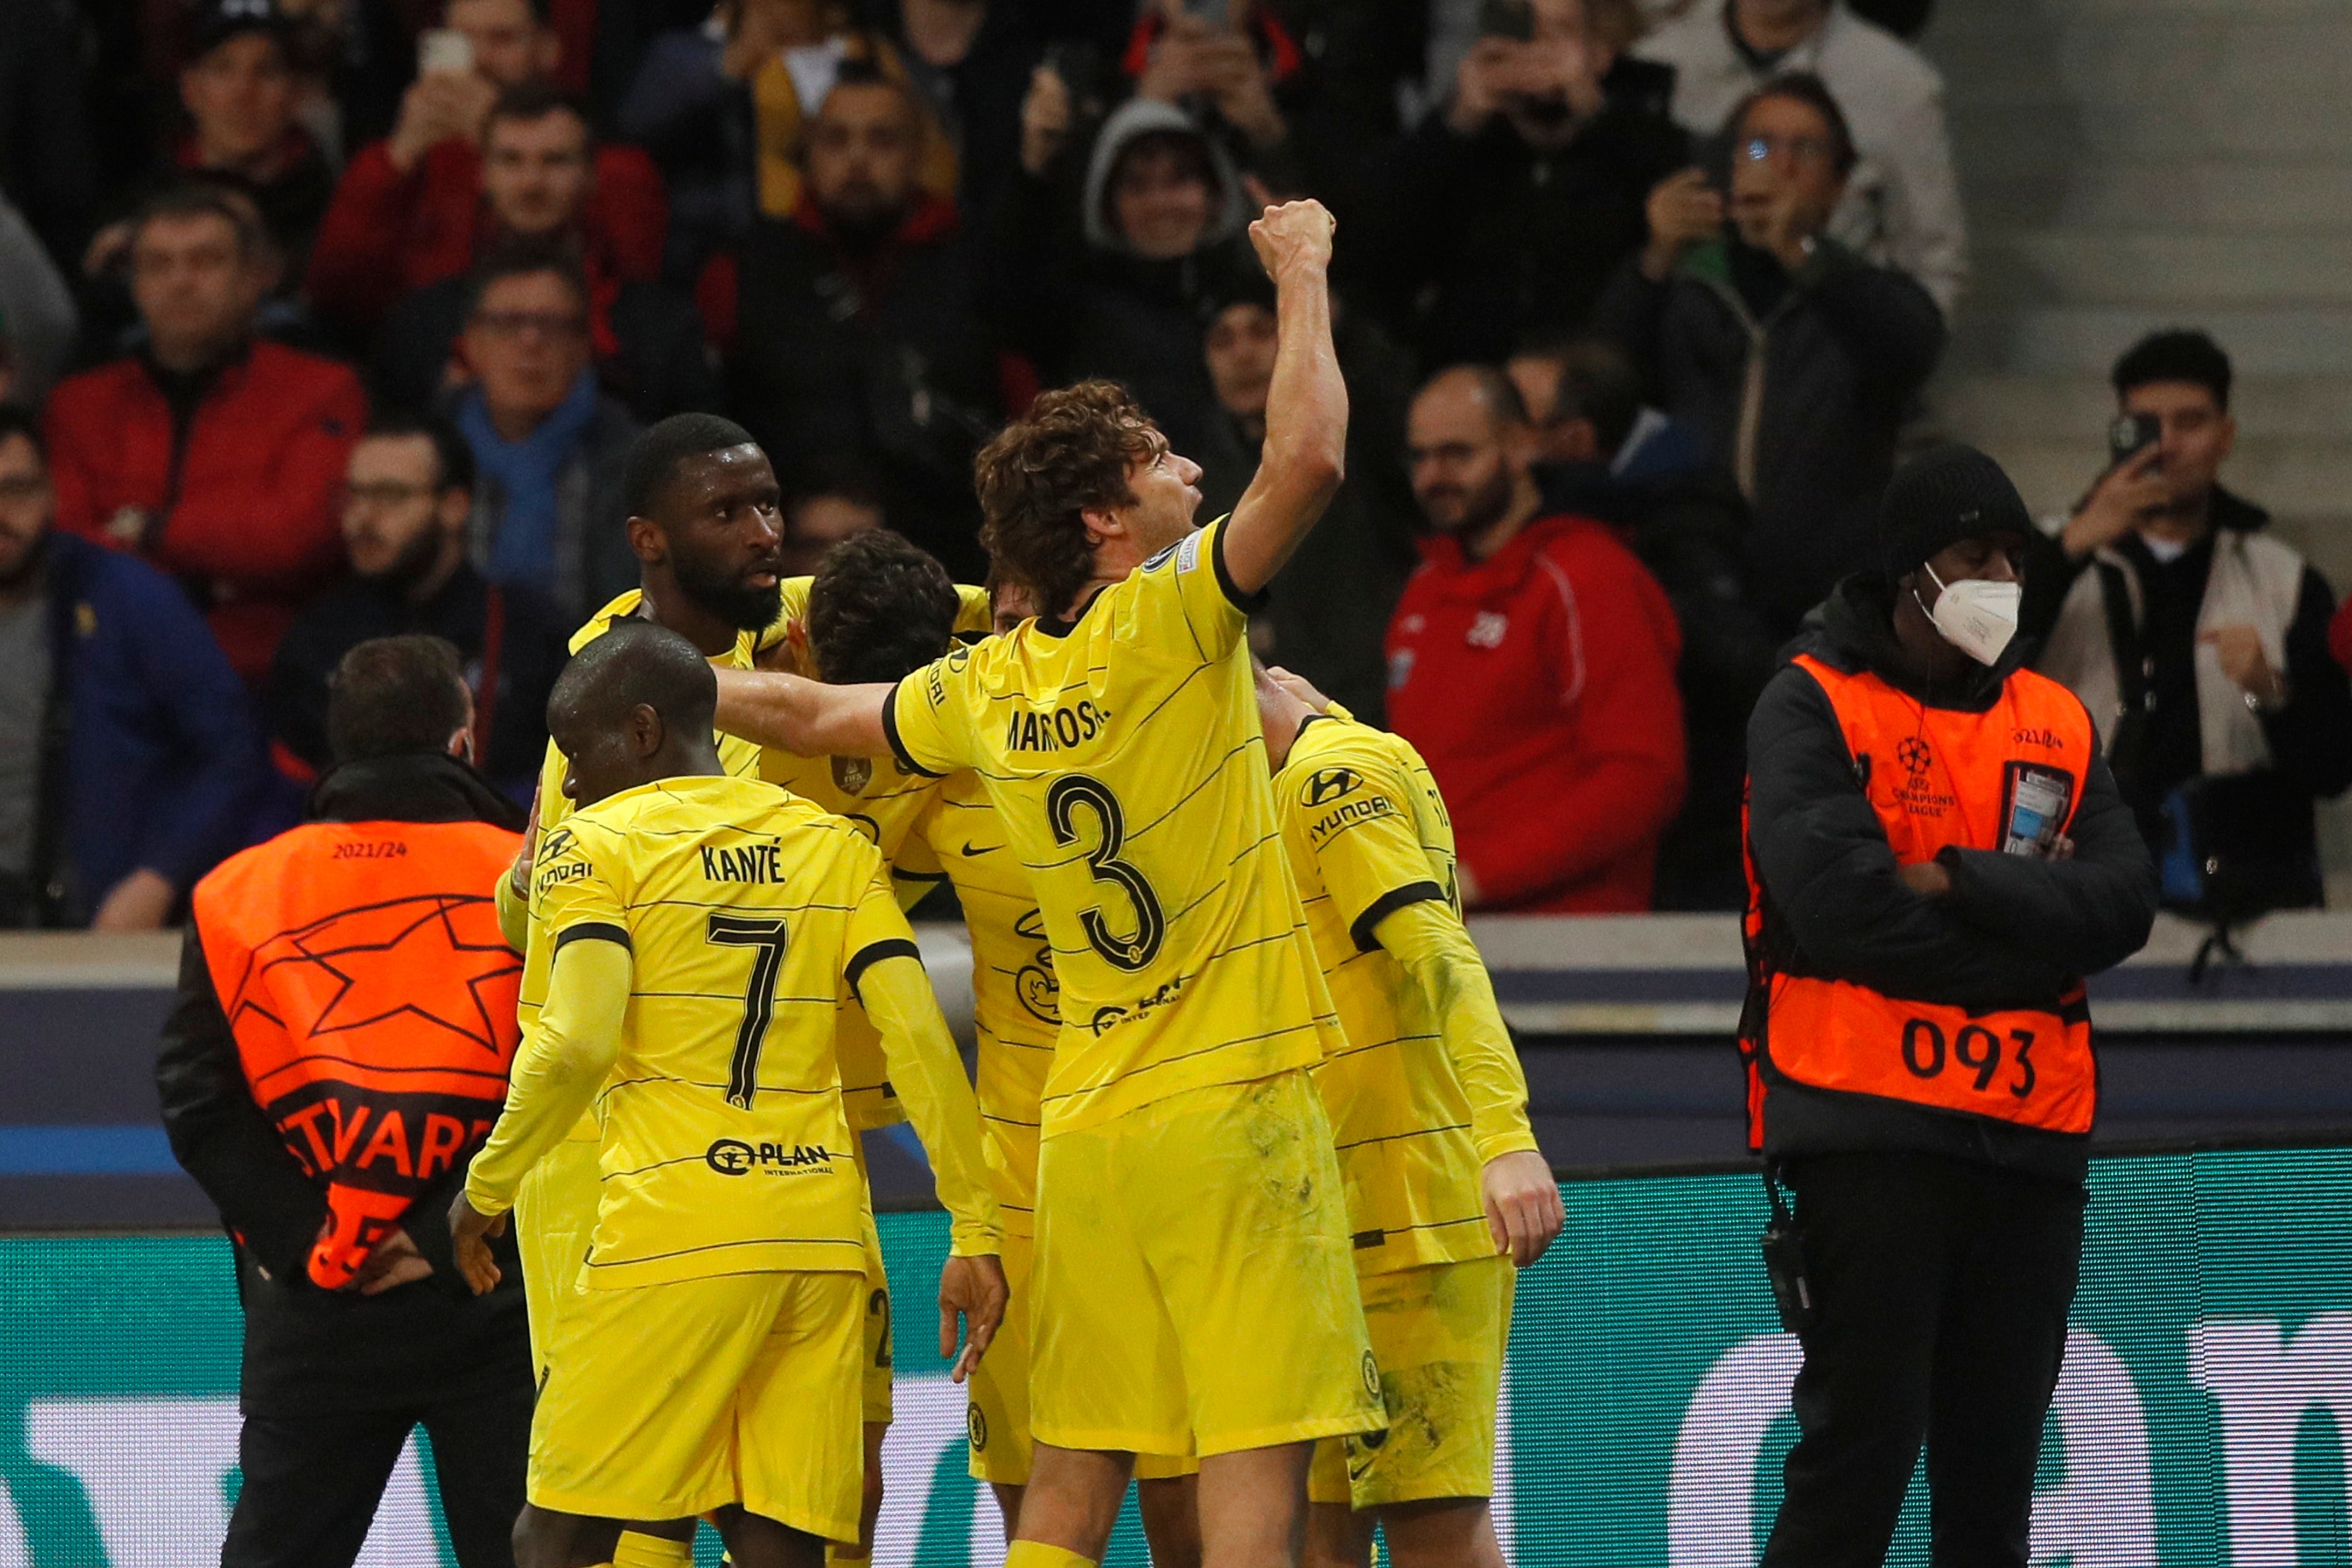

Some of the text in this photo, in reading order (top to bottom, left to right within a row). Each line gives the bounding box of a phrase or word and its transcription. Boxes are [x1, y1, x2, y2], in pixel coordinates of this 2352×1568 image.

[332, 841, 408, 859] 2021/24
[700, 837, 785, 884] KANTÉ
[1046, 772, 1166, 974] 3
[706, 912, 788, 1111] 7
[1902, 1018, 2035, 1097] 093
[760, 1143, 830, 1166] PLAN
[764, 1167, 834, 1176] INTERNATIONAL
